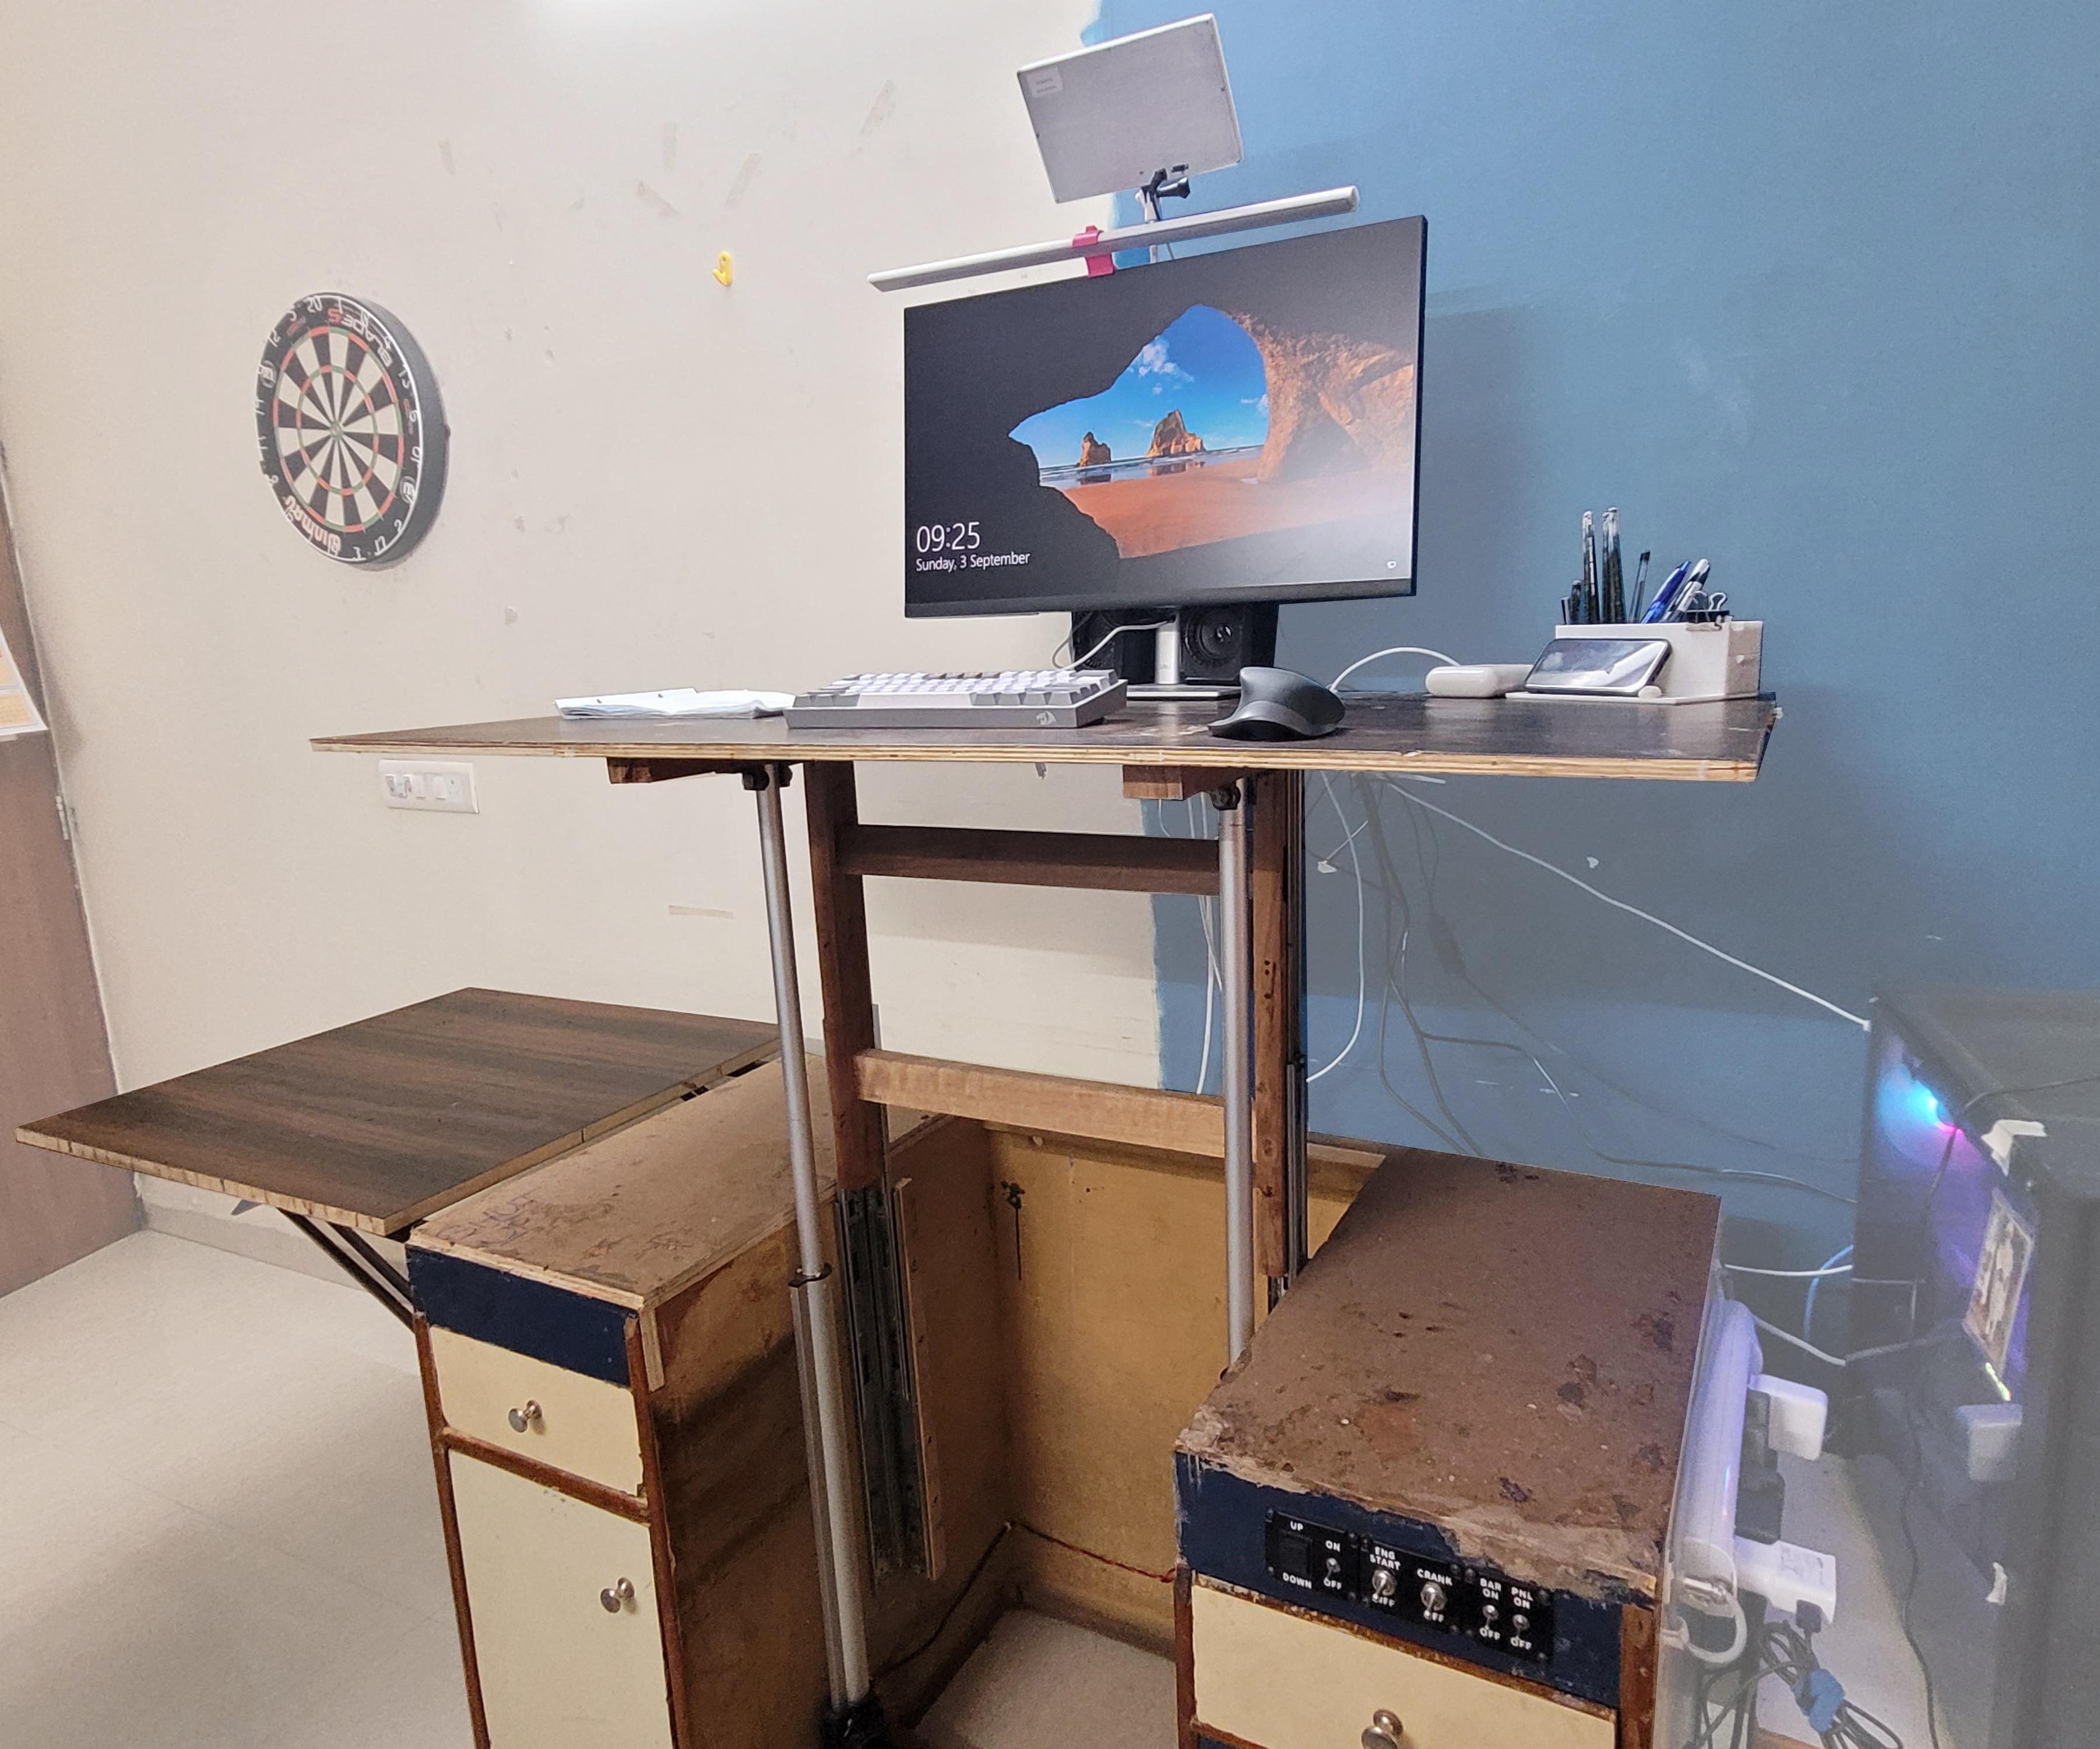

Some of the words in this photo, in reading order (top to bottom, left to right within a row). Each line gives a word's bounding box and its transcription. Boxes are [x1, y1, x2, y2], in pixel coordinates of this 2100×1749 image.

[916, 521, 980, 553] 09:25
[916, 556, 957, 573] Sunday,
[959, 554, 968, 569] 3
[970, 550, 1031, 570] September
[1290, 1520, 1304, 1532] UP
[1325, 1540, 1341, 1553] ON
[1374, 1546, 1396, 1560] ENG
[1370, 1554, 1402, 1571] START
[1283, 1572, 1313, 1590] DOWN
[1323, 1577, 1342, 1590] OFF
[1416, 1568, 1453, 1586] CRANK
[1480, 1578, 1502, 1592] BAR
[1482, 1588, 1500, 1601] ON
[1511, 1586, 1534, 1602] PNL
[1513, 1596, 1531, 1610] ON
[1479, 1626, 1501, 1641] OFF
[1510, 1636, 1532, 1650] OFF
